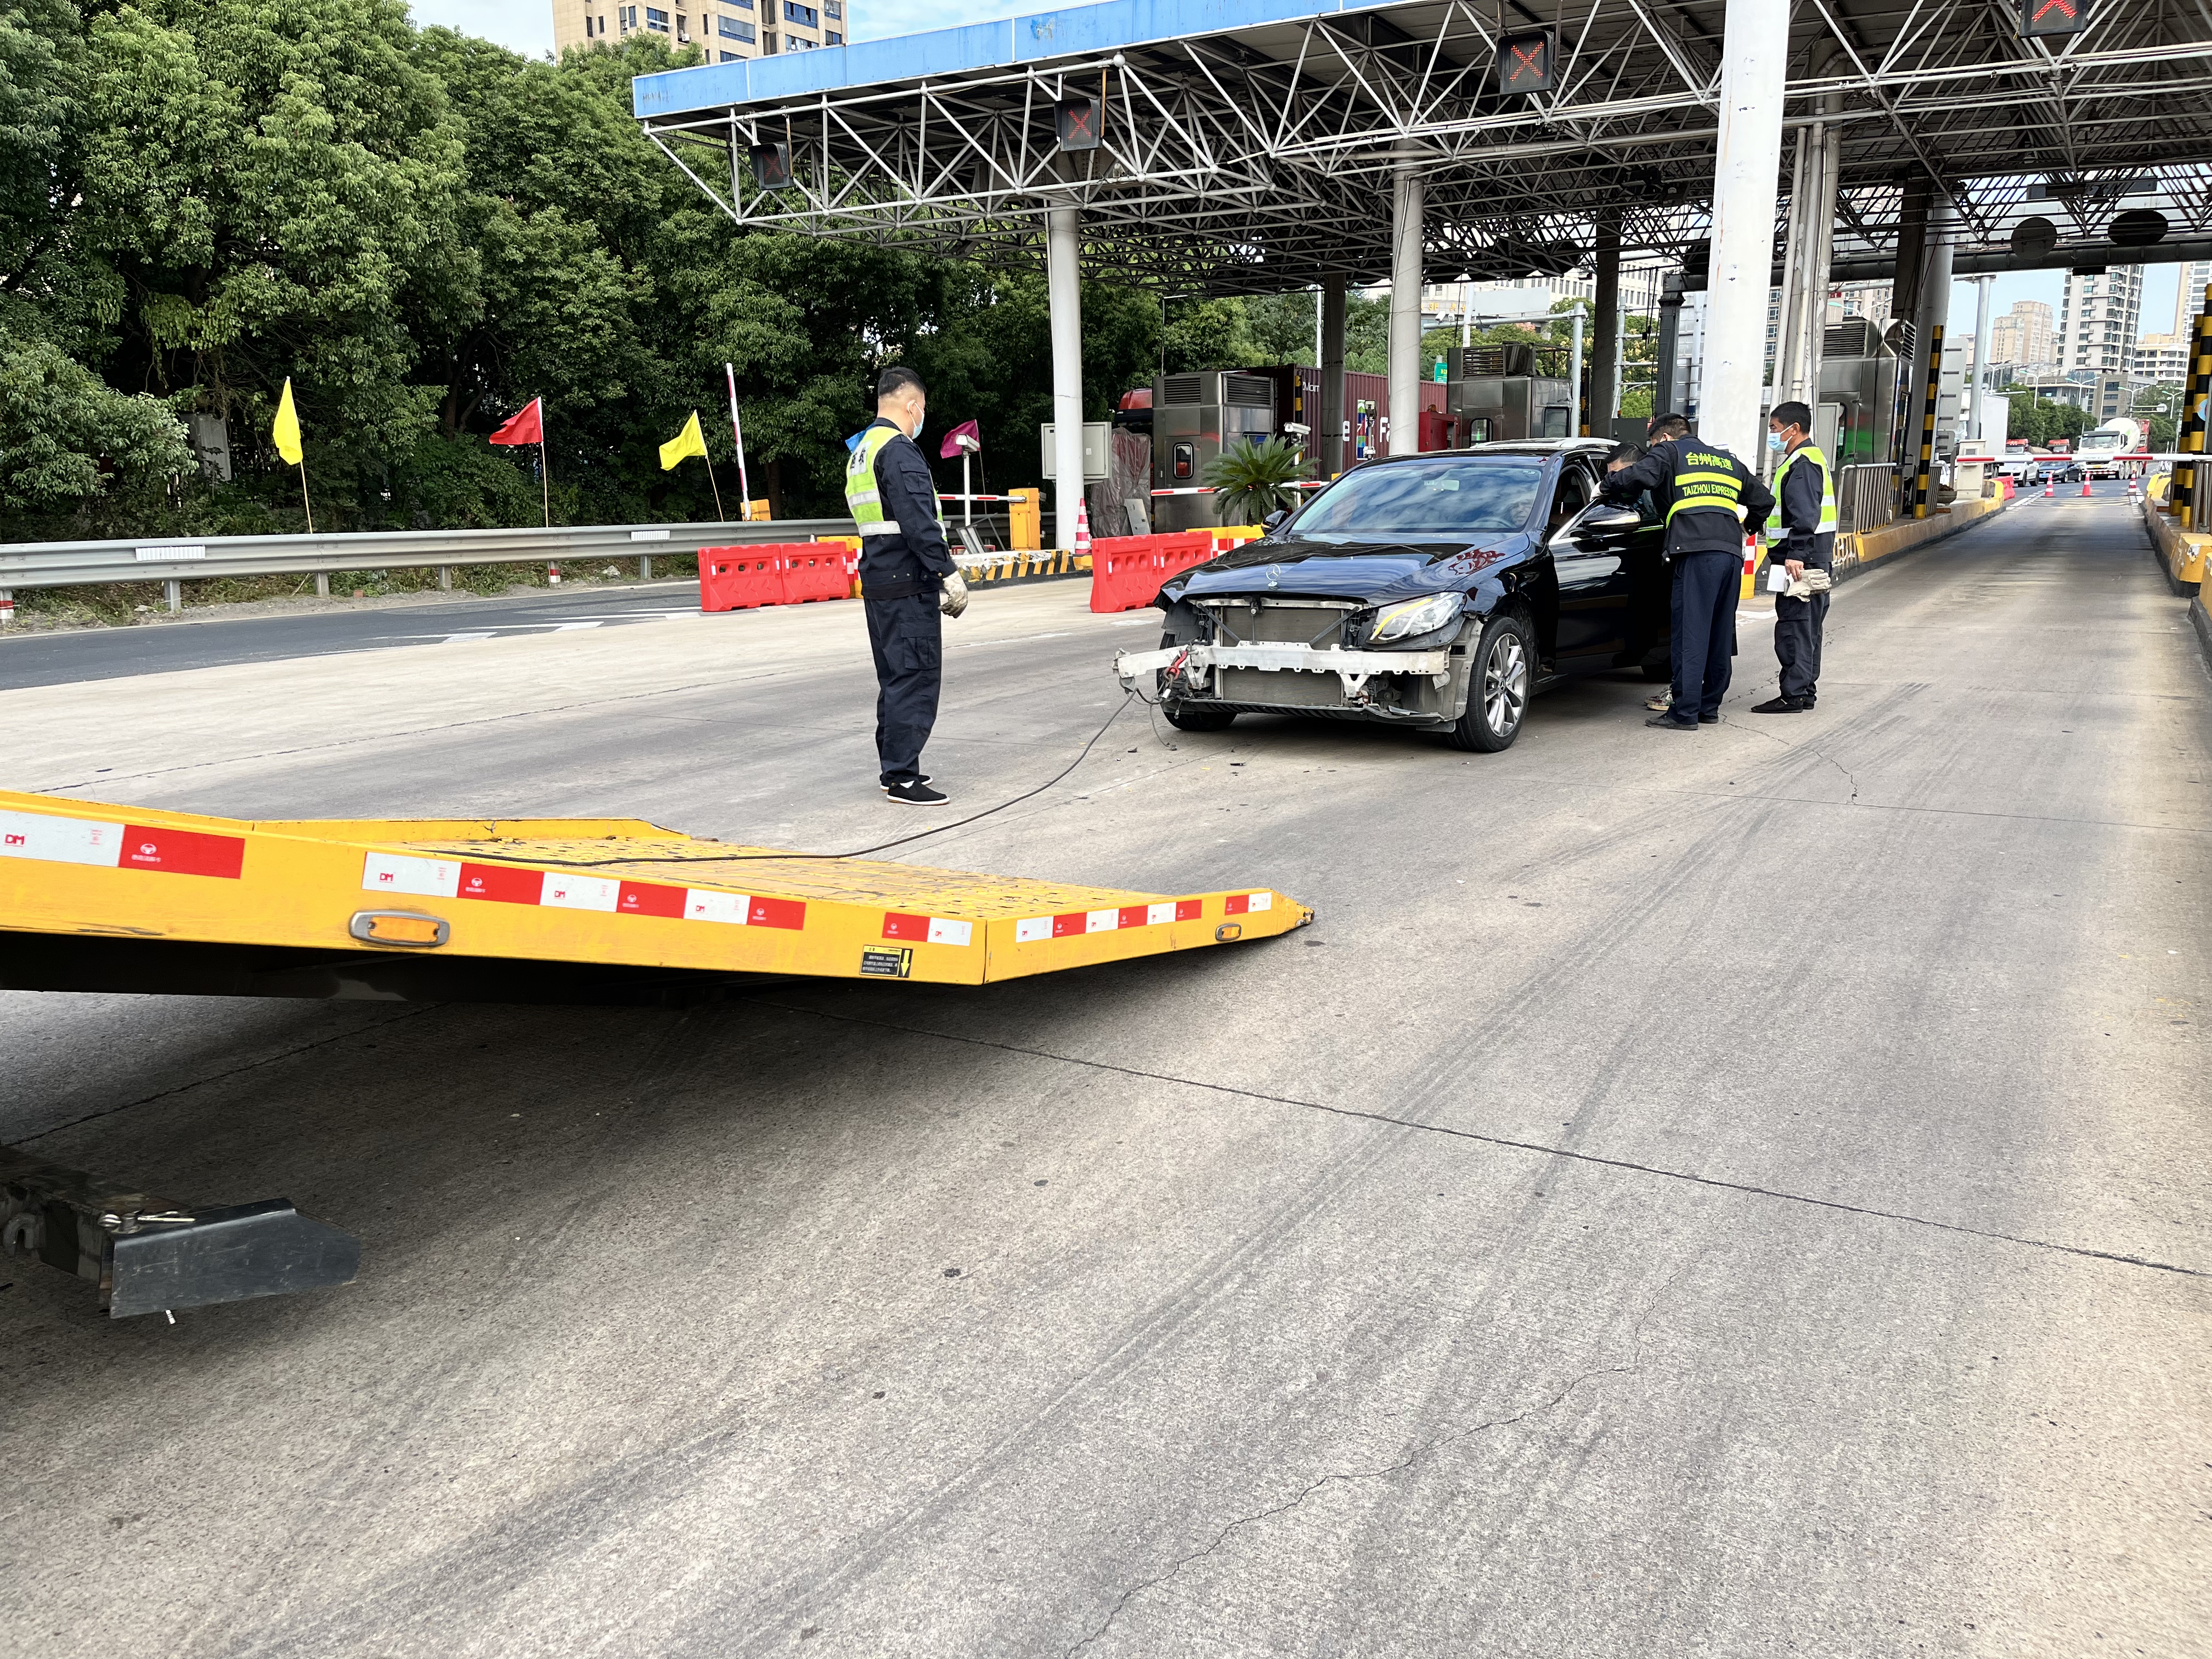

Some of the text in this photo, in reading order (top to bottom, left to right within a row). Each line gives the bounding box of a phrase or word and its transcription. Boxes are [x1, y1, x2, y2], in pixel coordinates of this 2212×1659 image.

[1685, 452, 1734, 471] 台州高速
[1682, 483, 1711, 496] TAIZHOU
[4, 834, 25, 845] DM
